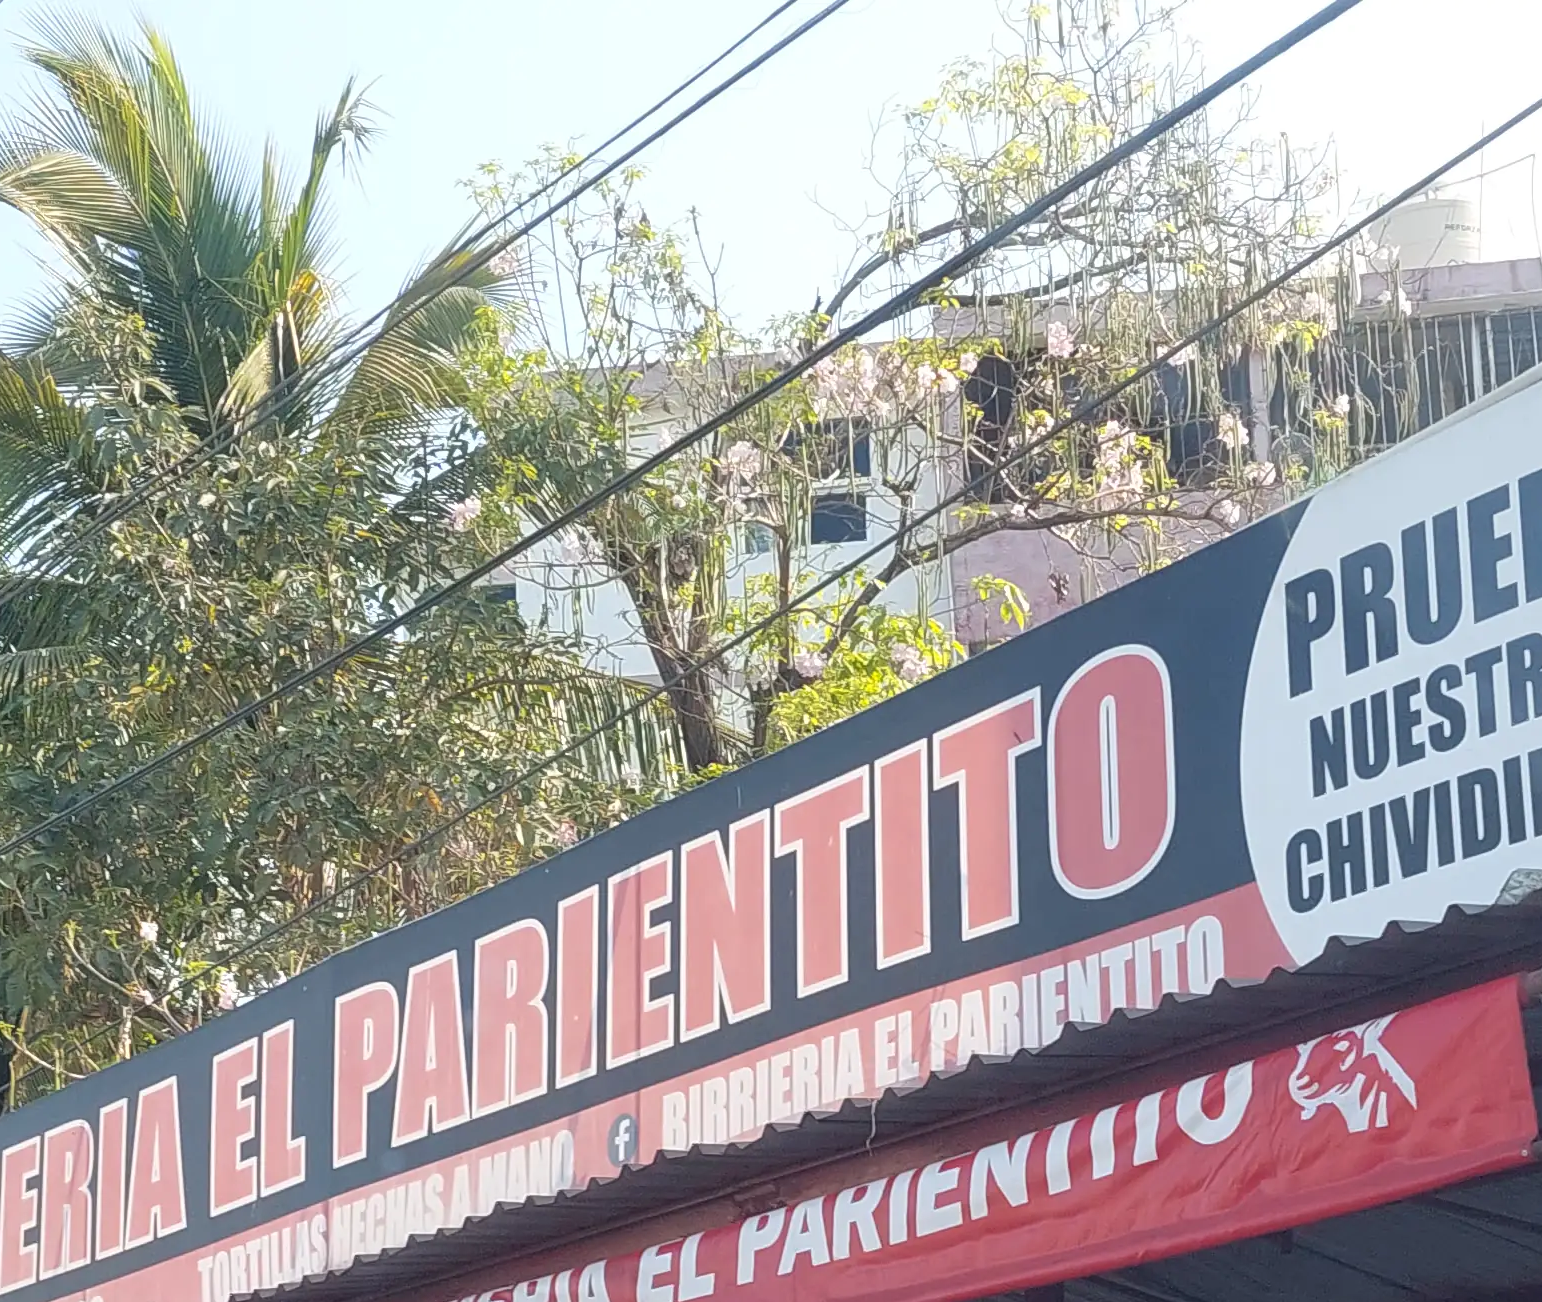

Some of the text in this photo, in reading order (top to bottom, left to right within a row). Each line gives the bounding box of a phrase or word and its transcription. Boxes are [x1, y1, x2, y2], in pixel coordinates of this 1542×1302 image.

[209, 1019, 306, 1217] EL
[333, 643, 1177, 1170] PARIENTITO
[662, 915, 1226, 1152] BIRRIERIA EL PARIENTITO
[328, 1172, 445, 1272] HECHAS
[449, 1163, 471, 1230] A
[477, 1129, 575, 1217] MANO
